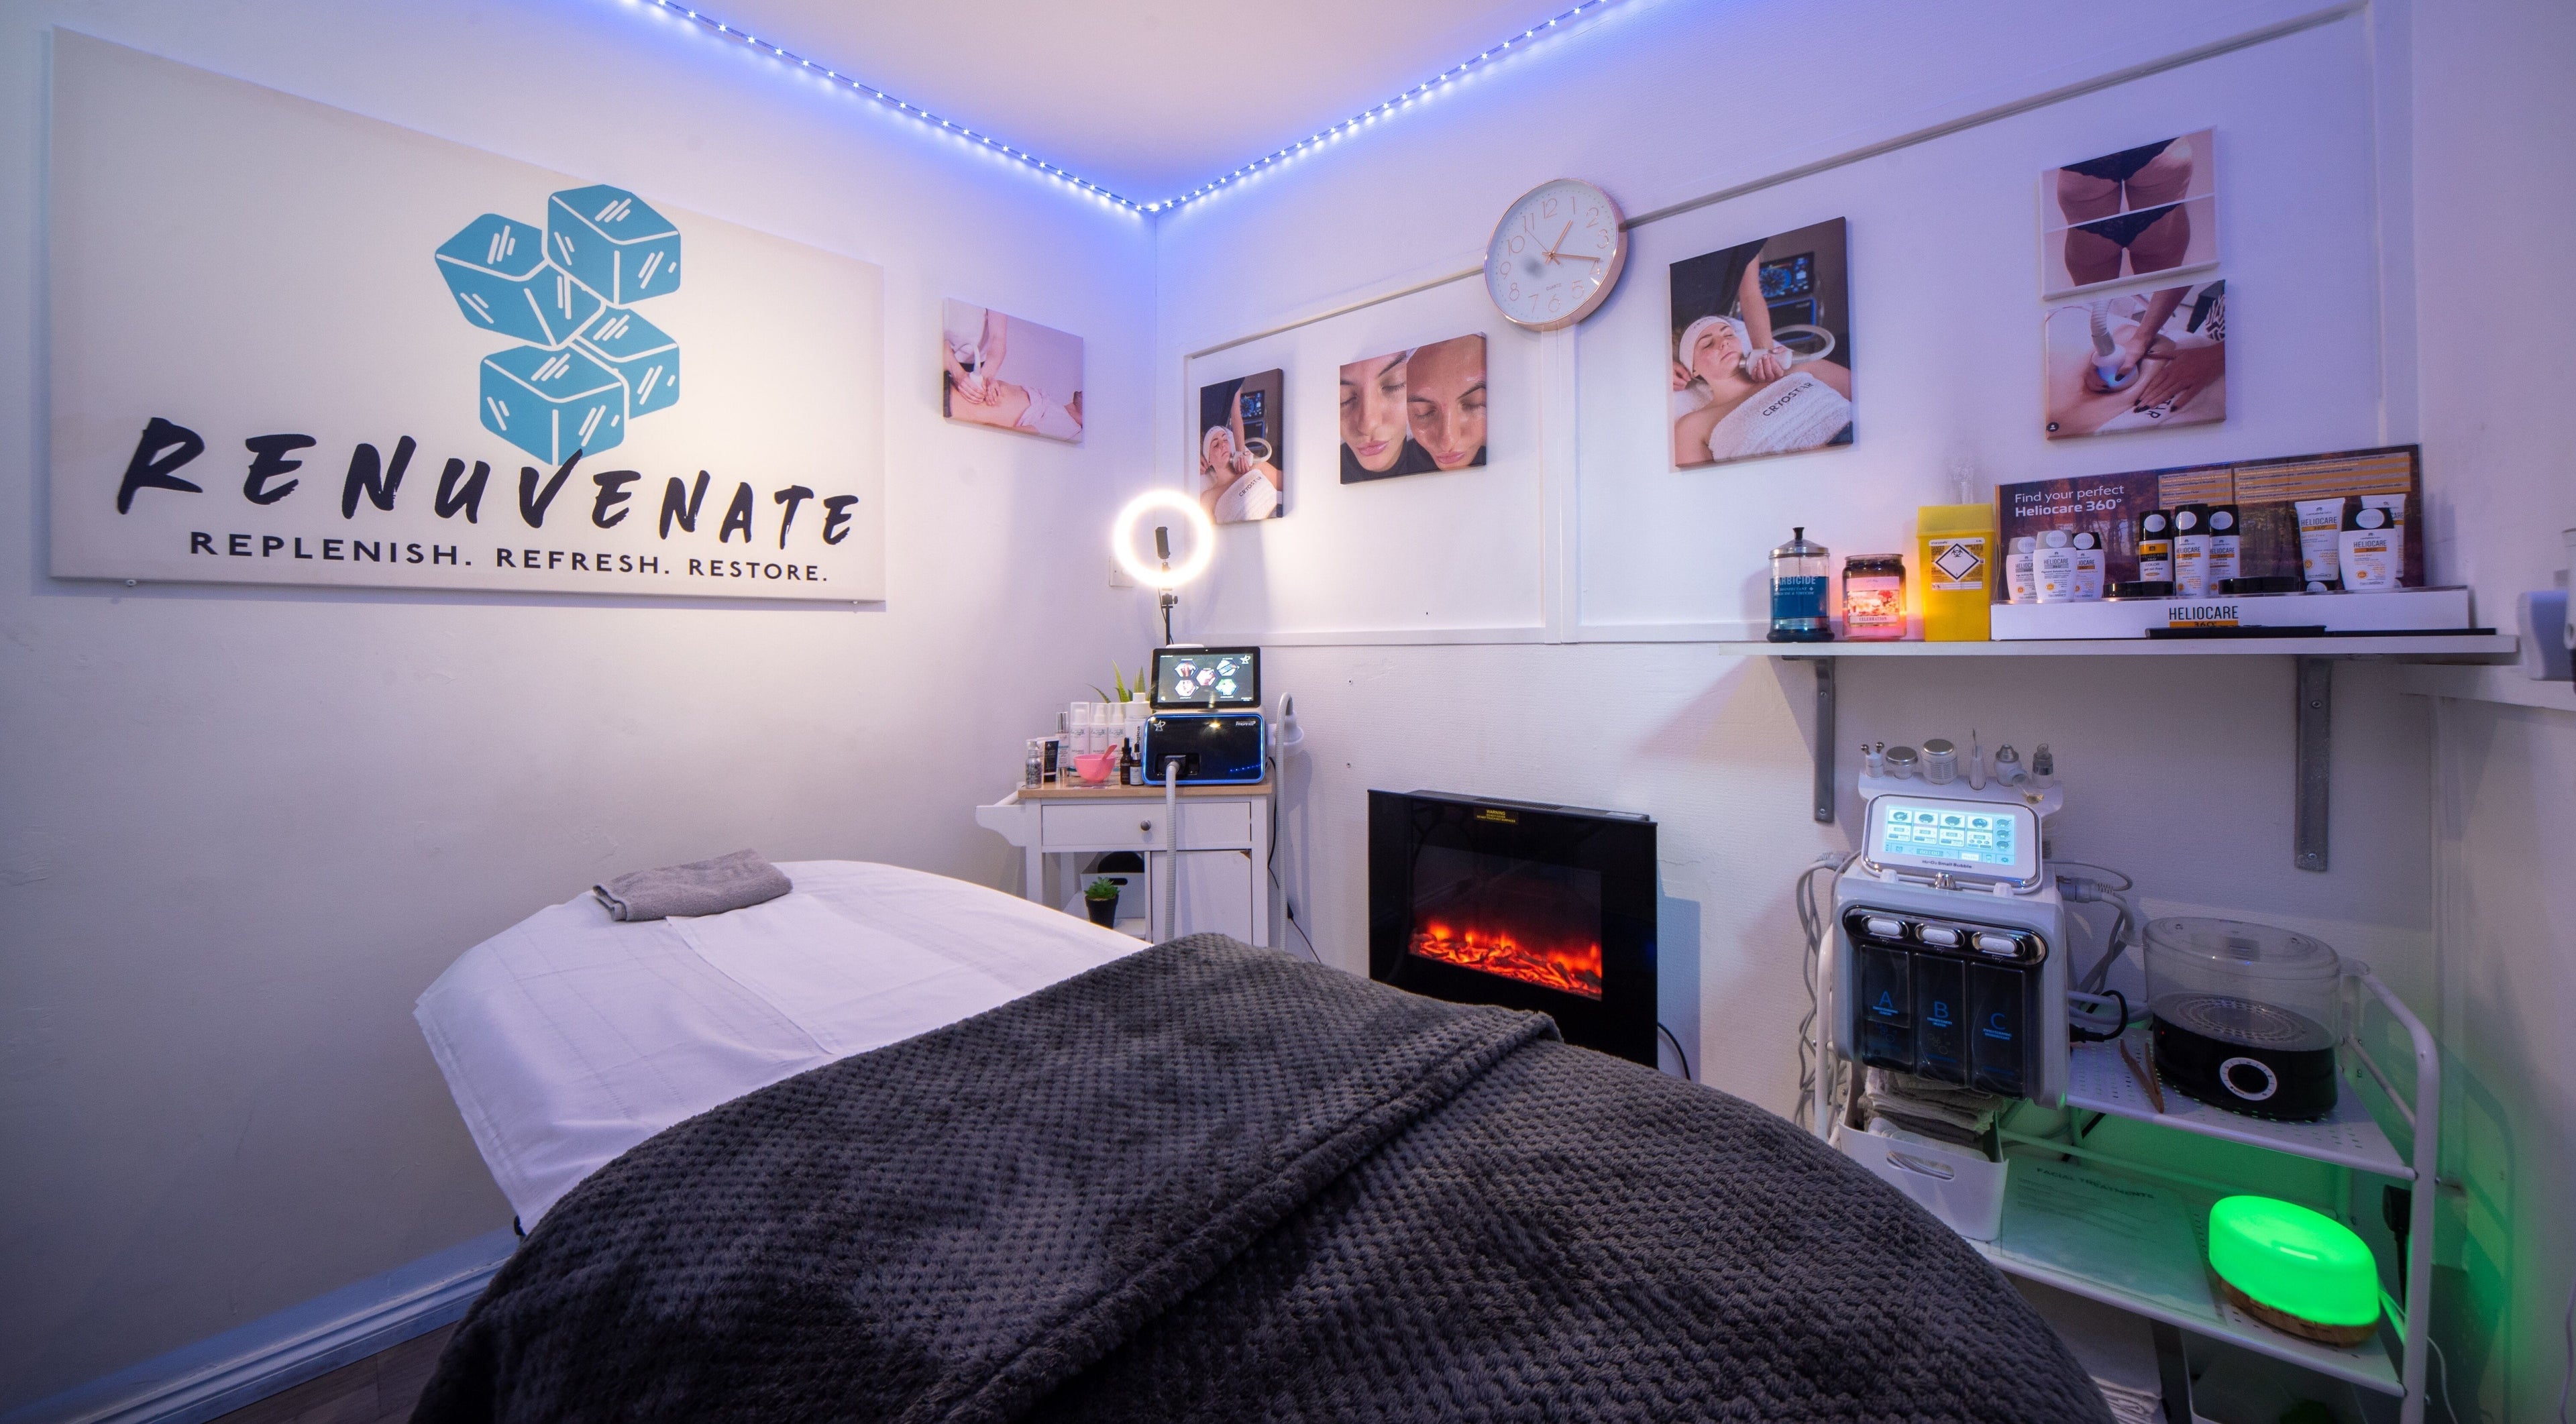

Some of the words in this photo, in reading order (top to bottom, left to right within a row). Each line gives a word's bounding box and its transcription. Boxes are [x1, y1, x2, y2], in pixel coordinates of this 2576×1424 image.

[1541, 198, 1558, 219] 12
[1570, 196, 1576, 215] 1
[1522, 213, 1535, 233] 11
[1586, 207, 1599, 228] 2
[1506, 235, 1525, 256] 10
[1597, 229, 1609, 249] 3
[1499, 261, 1511, 280] 9
[1509, 282, 1519, 301] 8
[1572, 280, 1585, 299] 5
[1528, 294, 1539, 313] 7
[1548, 293, 1561, 313] 6
[116, 416, 859, 552] RENUVENATE
[2015, 491, 2041, 503] Find
[2045, 490, 2074, 503] your
[2077, 485, 2125, 500] perfect
[2015, 504, 2082, 517] Heliocare
[2086, 498, 2123, 512] 360°
[2301, 516, 2337, 527] HELIOCARE
[2353, 540, 2387, 548] HELIOCARE
[189, 531, 473, 567] REPLENISH.
[496, 547, 670, 576] REFRESH.
[688, 557, 829, 584] RESTORE.
[1775, 576, 1816, 586] ARBICIDE
[2169, 606, 2239, 620] HELIOCARE
[1879, 991, 1893, 1007] A
[1934, 1001, 1949, 1018] B
[1990, 1013, 2006, 1030] C
[2036, 1167, 2076, 1181] FACIAL
